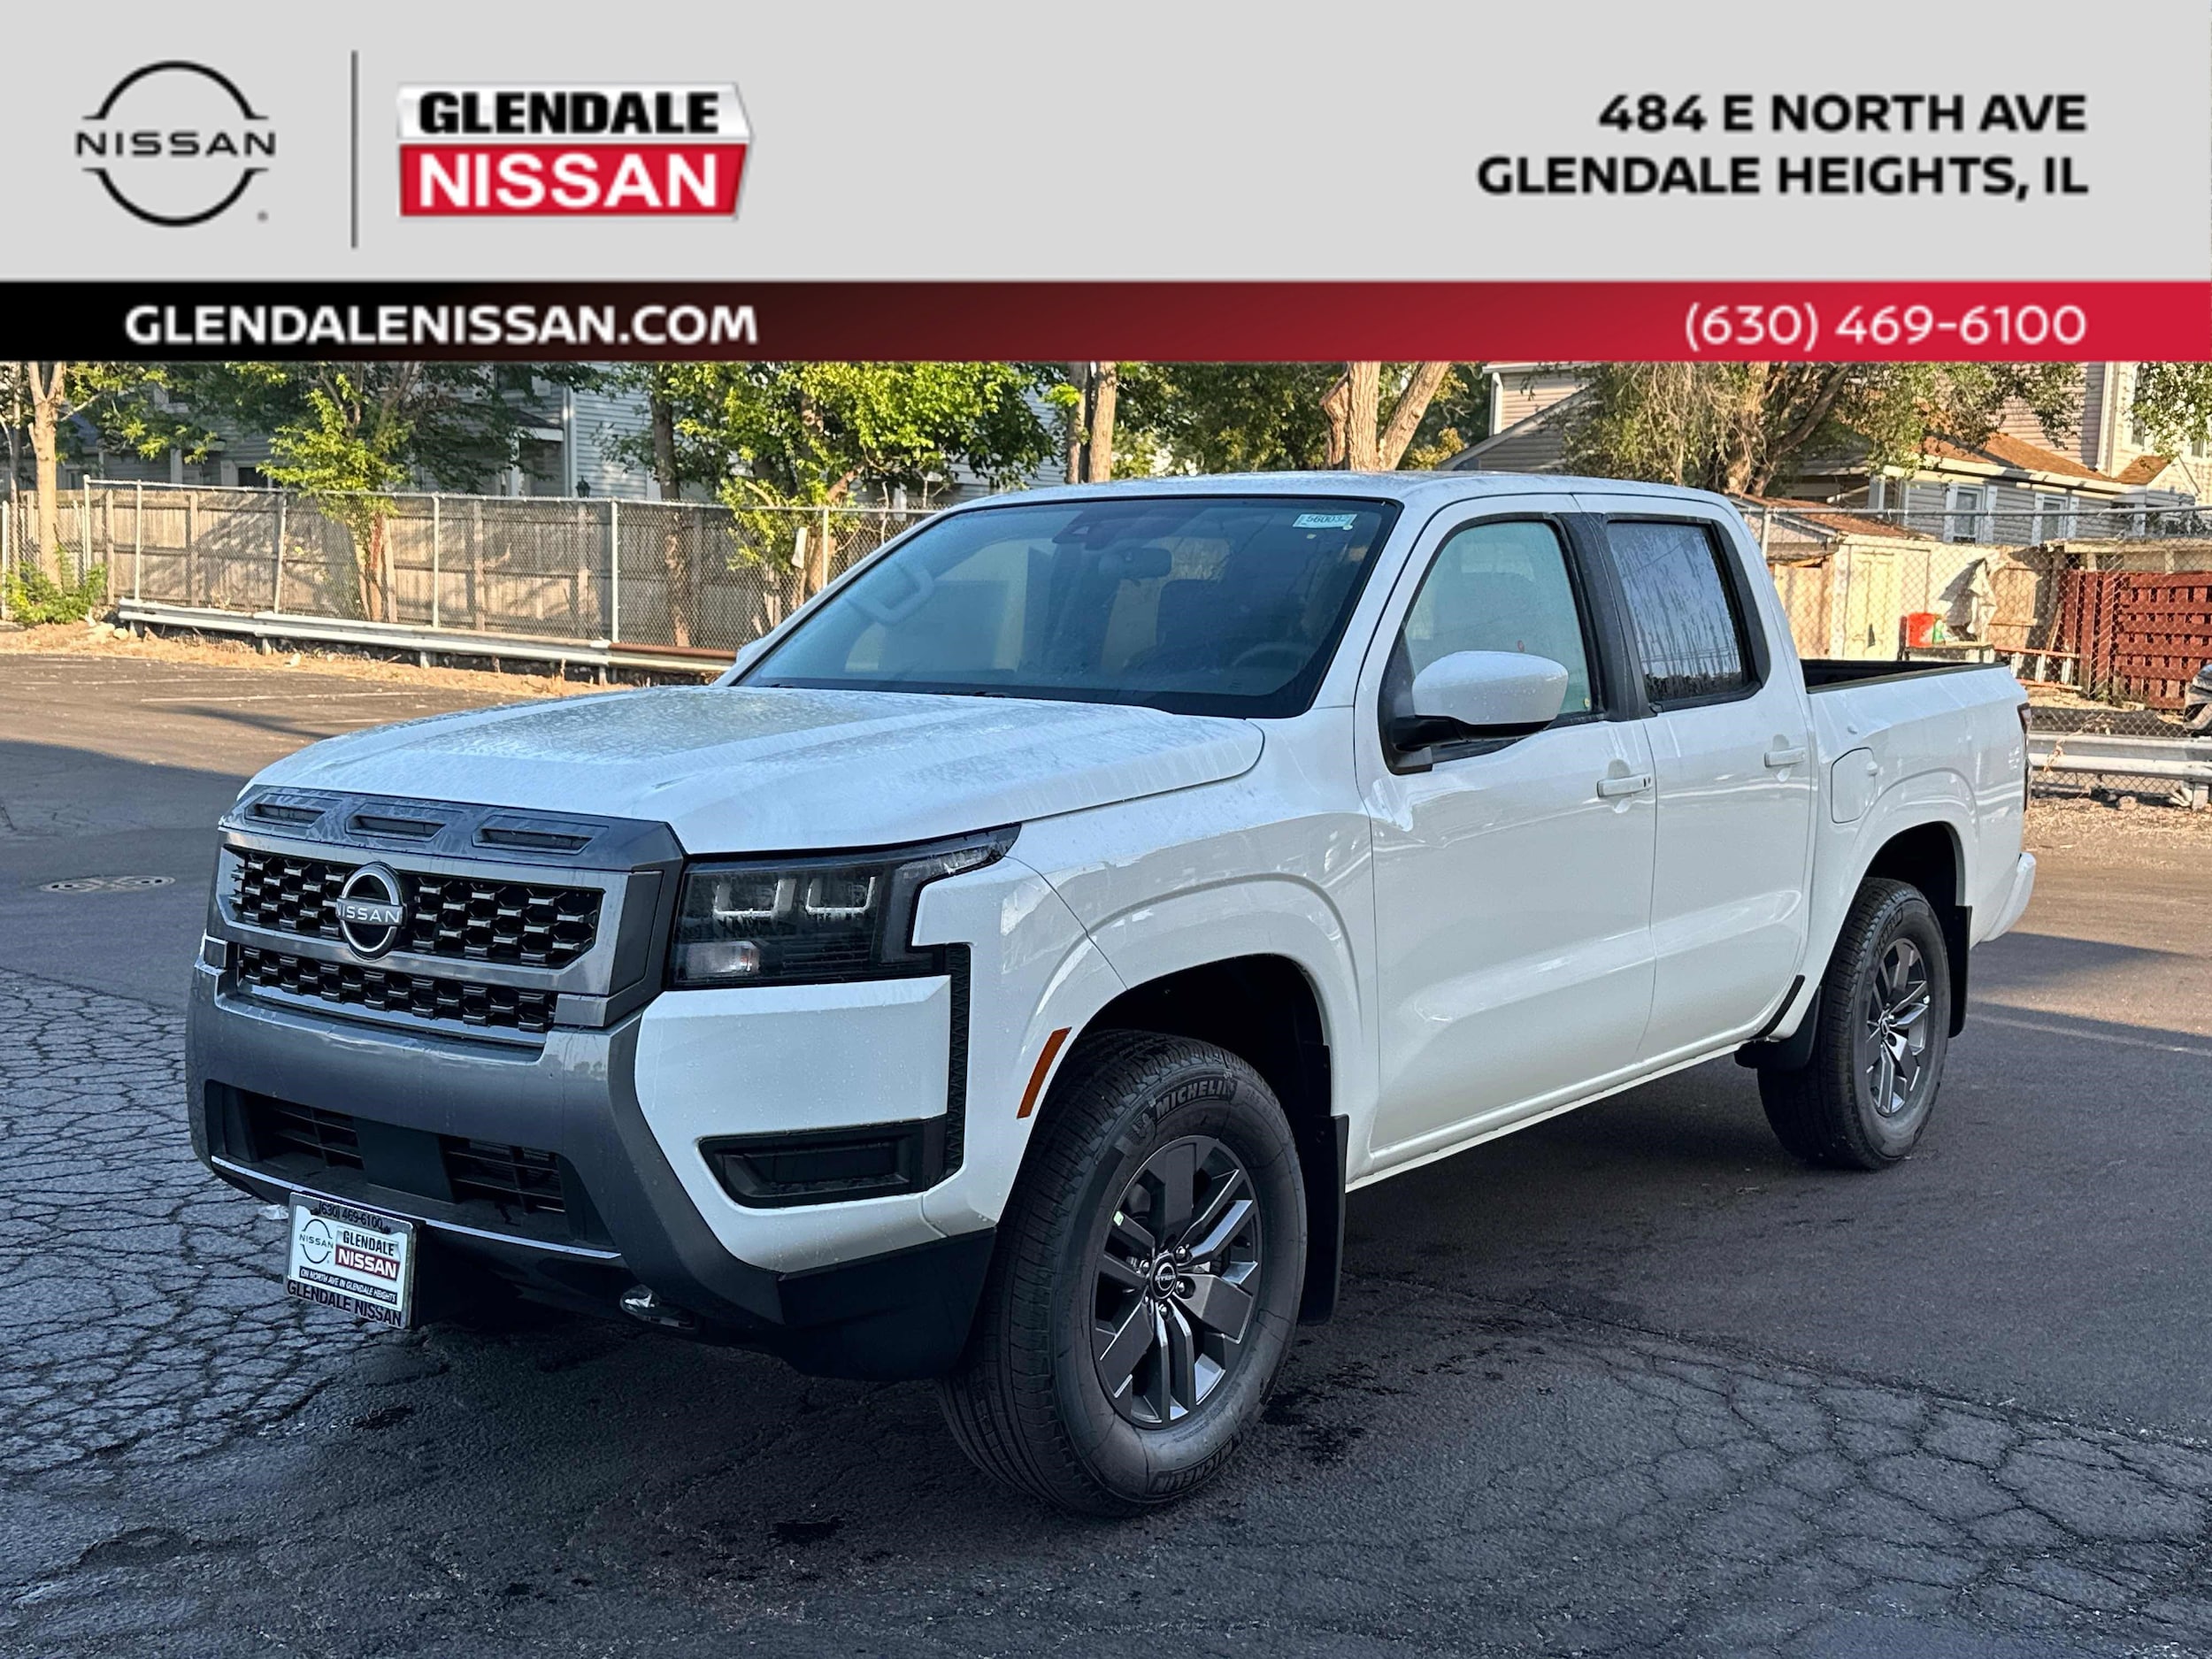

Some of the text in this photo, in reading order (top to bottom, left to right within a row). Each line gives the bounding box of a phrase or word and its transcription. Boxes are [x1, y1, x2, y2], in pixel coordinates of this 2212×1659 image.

[337, 902, 401, 924] NISSAN
[1156, 1079, 1235, 1119] MICHELIN
[299, 1233, 334, 1249] NISSAN
[342, 1230, 395, 1257] GLENDALE
[338, 1248, 397, 1279] NISSAN
[287, 1279, 402, 1327] GLENDALE NISSAN
